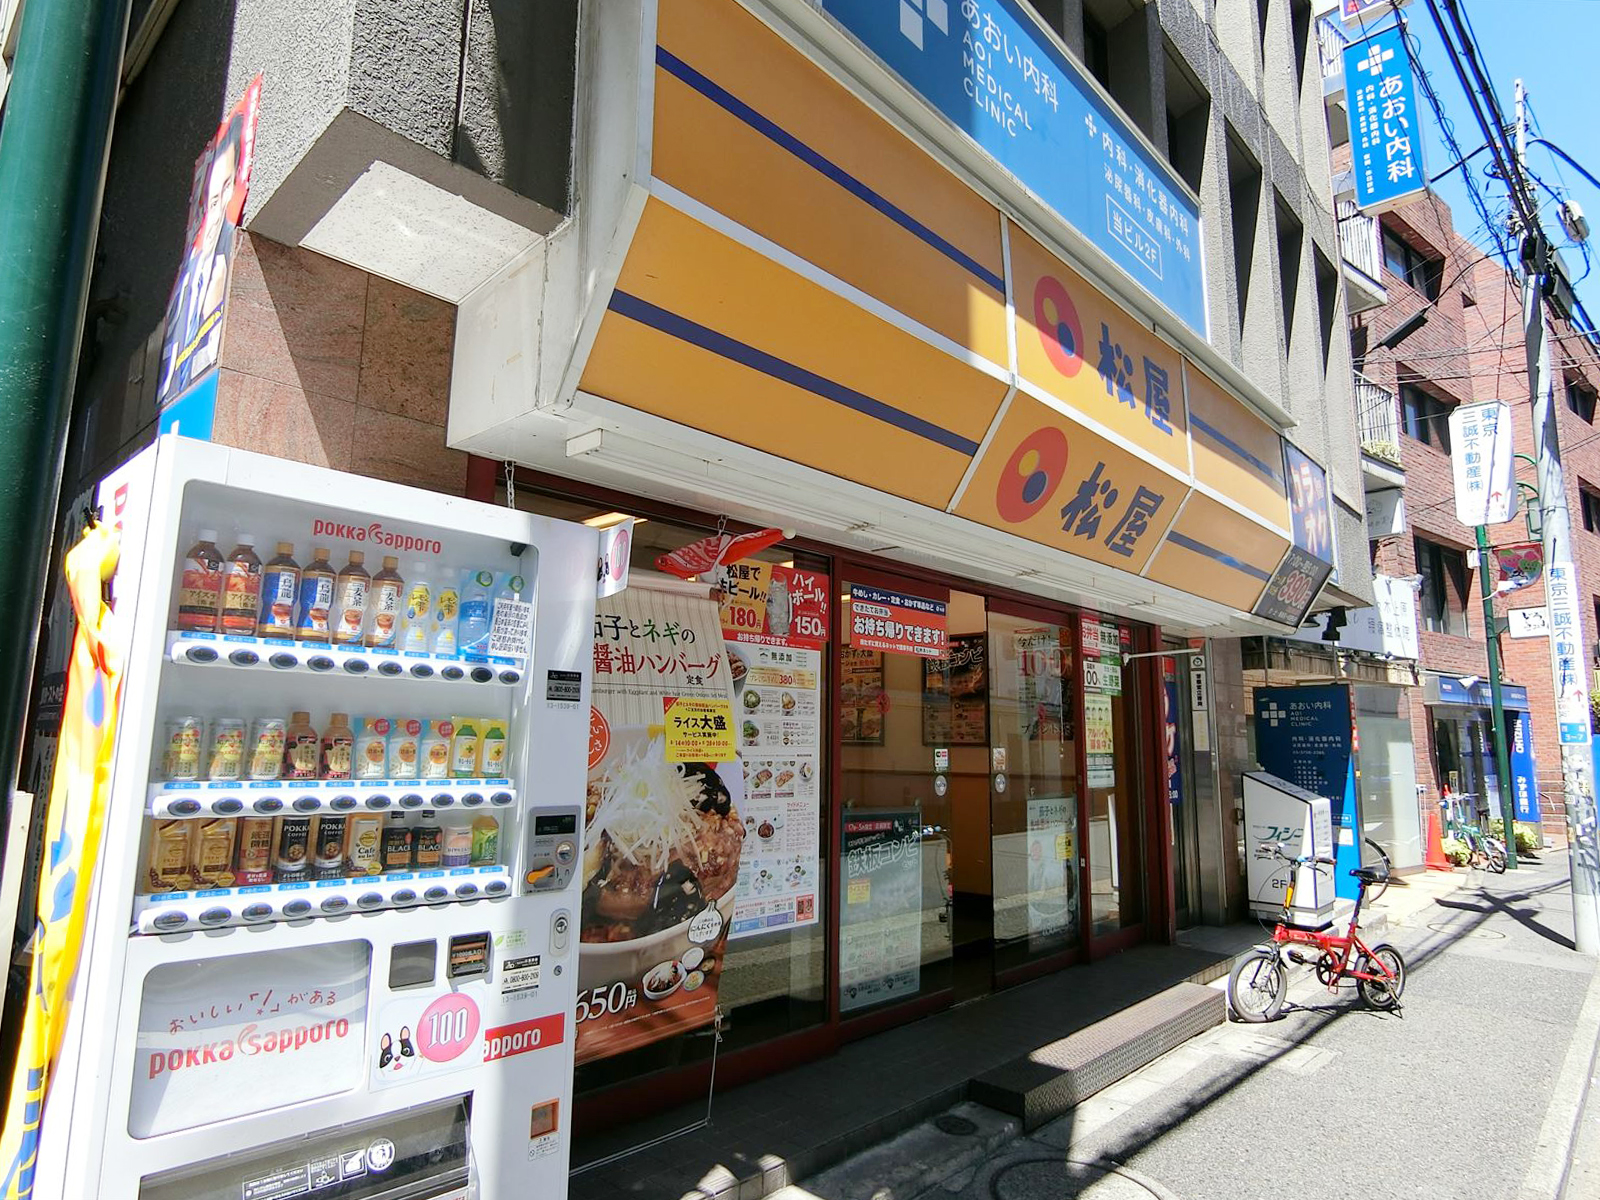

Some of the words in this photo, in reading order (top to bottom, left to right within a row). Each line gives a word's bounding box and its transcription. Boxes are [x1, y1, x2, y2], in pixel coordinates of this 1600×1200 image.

[963, 30, 992, 70] AOI
[963, 50, 1032, 131] MEDICAL
[963, 77, 1016, 137] CLINIC
[1379, 74, 1415, 183] あおい内科
[1102, 132, 1189, 237] 内科・消化器内科
[1112, 209, 1157, 264] 当ビル2F
[1097, 321, 1172, 436] 松屋
[1481, 407, 1497, 437] 東京
[1060, 461, 1165, 558] 松屋
[726, 564, 761, 581] 松屋で
[792, 573, 815, 591] ハイ
[795, 616, 826, 637] 150円
[854, 616, 945, 646] お持ち帰りできます!
[594, 643, 721, 679] 醤油ハンバーグ
[687, 674, 704, 686] 定食
[674, 715, 727, 730] ライス大盛
[1290, 701, 1332, 710] あおい内科
[426, 1005, 468, 1049] 100
